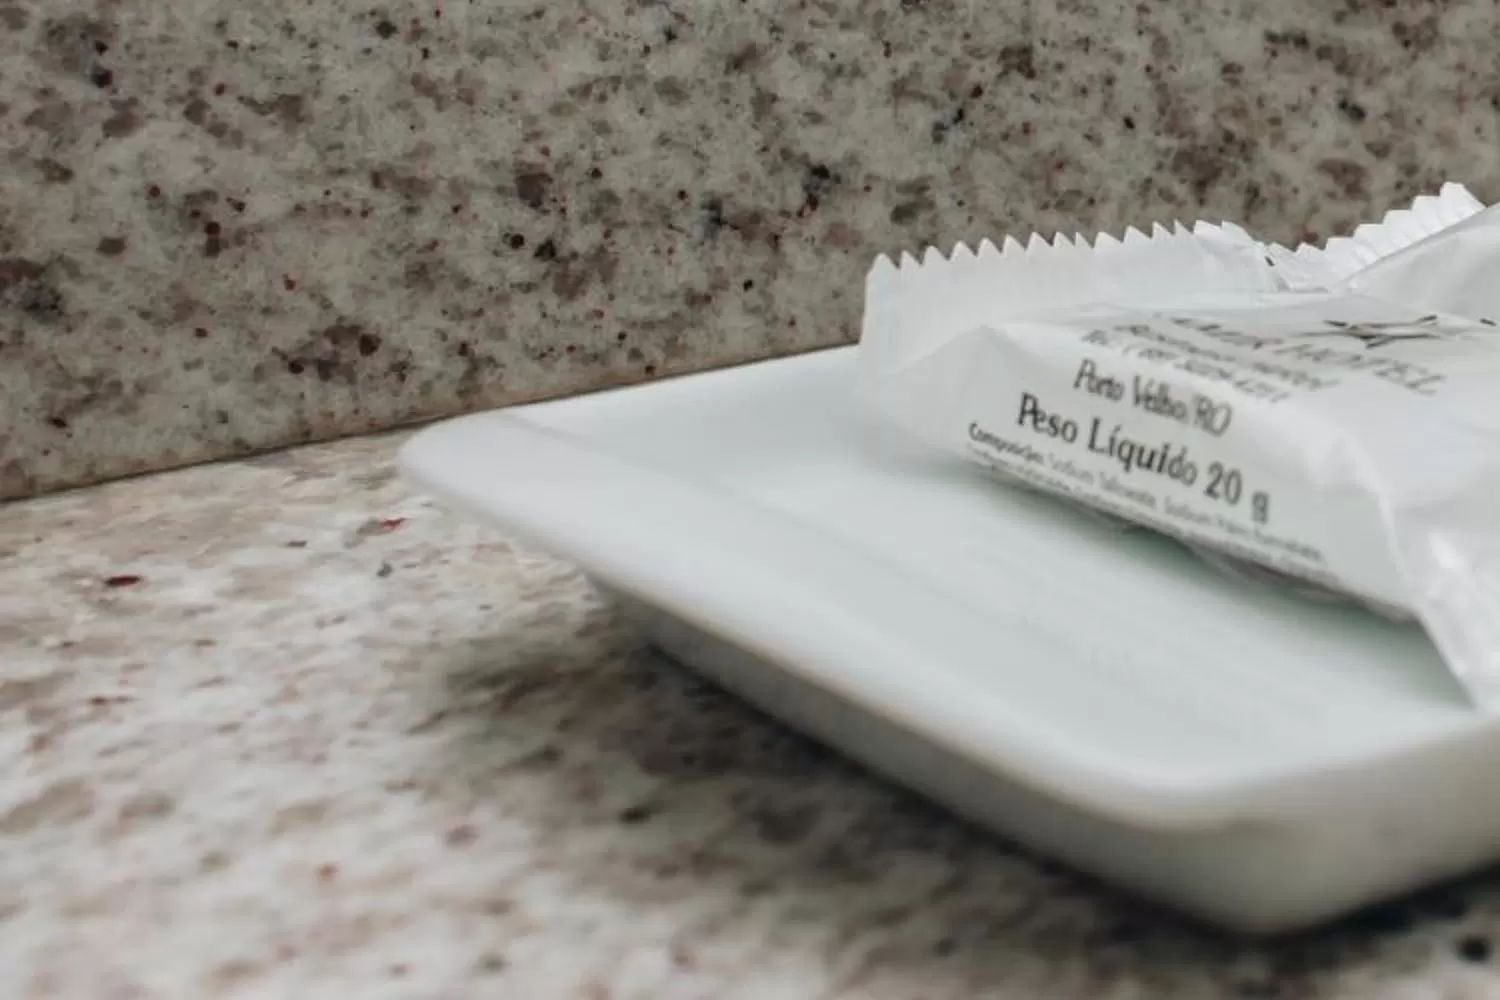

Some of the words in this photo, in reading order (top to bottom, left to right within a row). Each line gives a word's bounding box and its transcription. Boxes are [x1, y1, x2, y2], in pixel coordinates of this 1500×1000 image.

[1073, 357, 1125, 401] Porto
[1017, 391, 1078, 443] Peso
[1087, 416, 1198, 486] Líquido
[1203, 460, 1243, 506] 20
[1251, 490, 1271, 525] g
